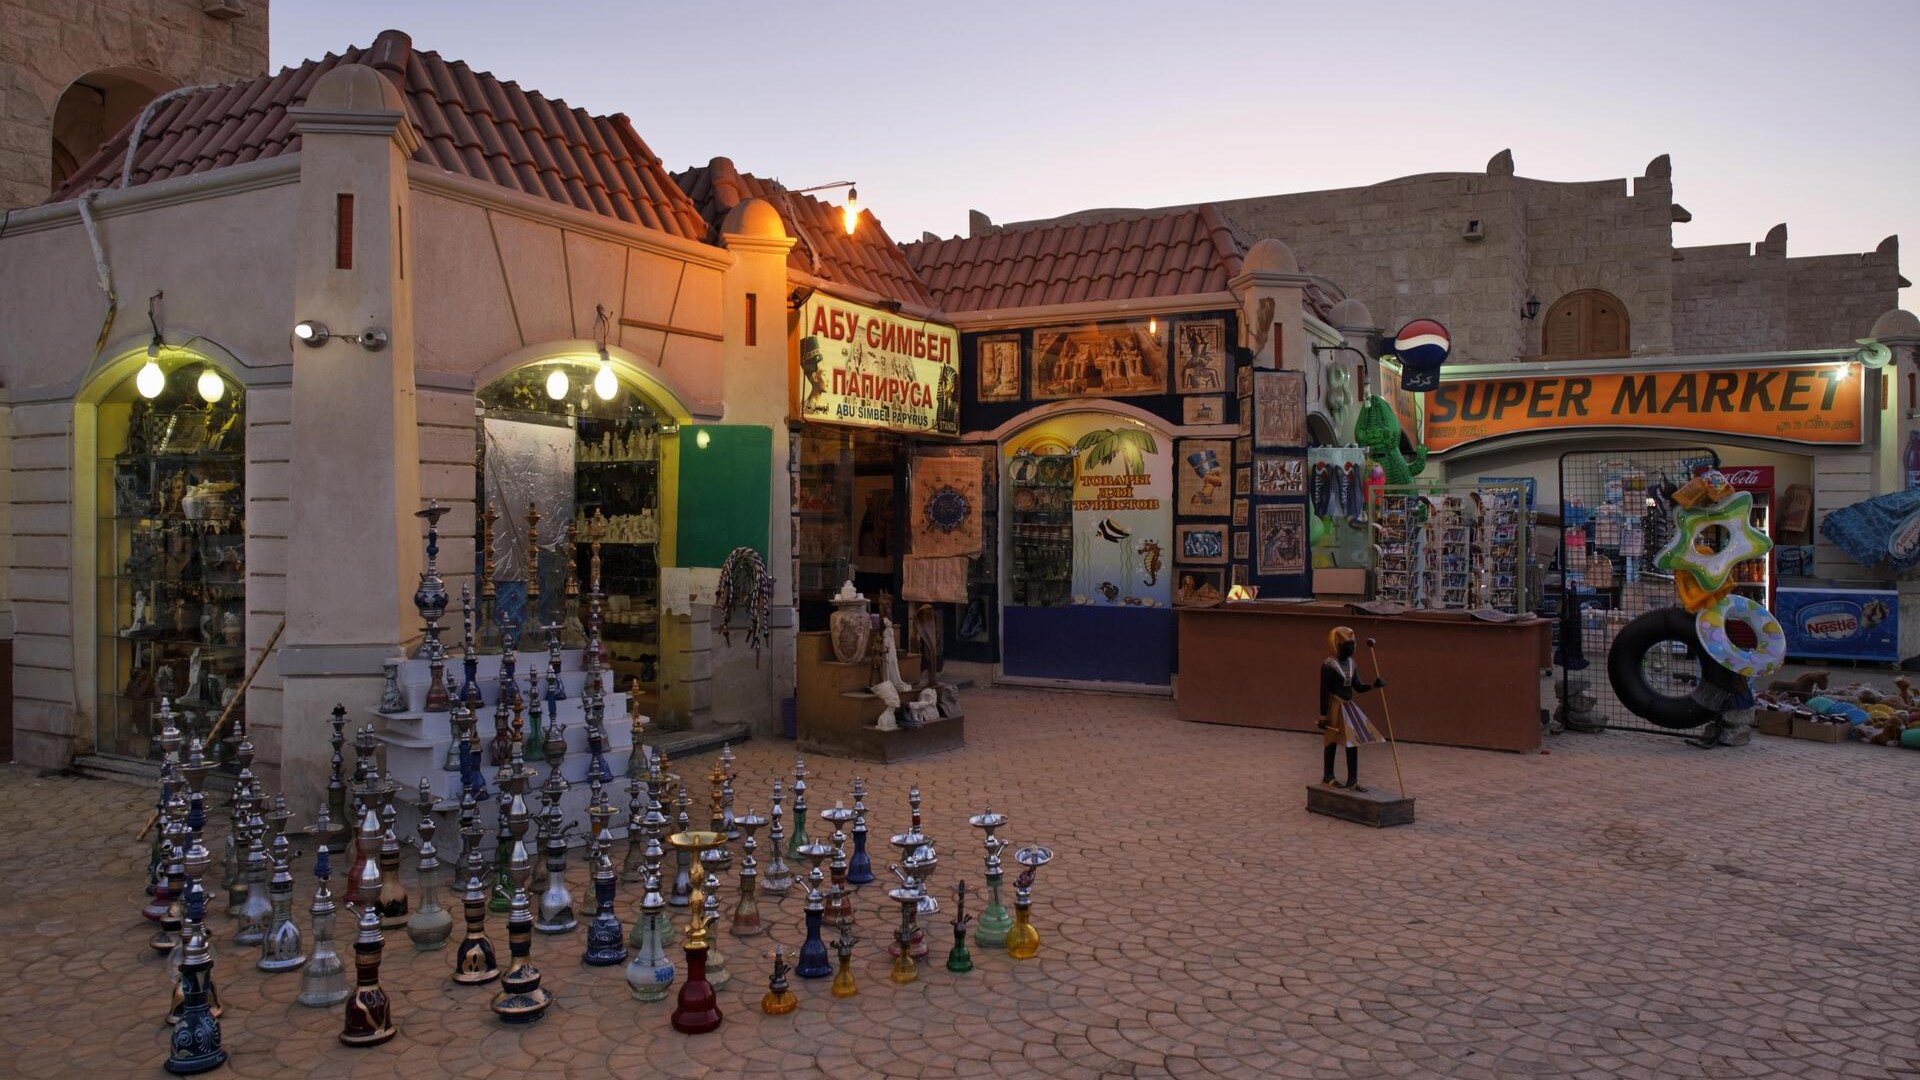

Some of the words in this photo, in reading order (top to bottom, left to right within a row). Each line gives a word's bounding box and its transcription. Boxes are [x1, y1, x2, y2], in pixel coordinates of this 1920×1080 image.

[812, 306, 859, 343] АБУ
[866, 318, 952, 365] СИМБЕЛ
[832, 368, 933, 409] ПАПИРУСА
[1429, 377, 1592, 422] SUPER
[1611, 371, 1851, 414] MARKET
[836, 403, 855, 418] ABU
[857, 405, 890, 422] SIMBEL
[892, 411, 928, 427] PAPYRUS
[1429, 426, 1456, 438] RED
[1459, 425, 1486, 437] SEA
[1080, 474, 1151, 487] ТОВАРЫ
[1097, 487, 1133, 499] ДЛЯ
[1073, 499, 1159, 510] ТУРИСТОВ
